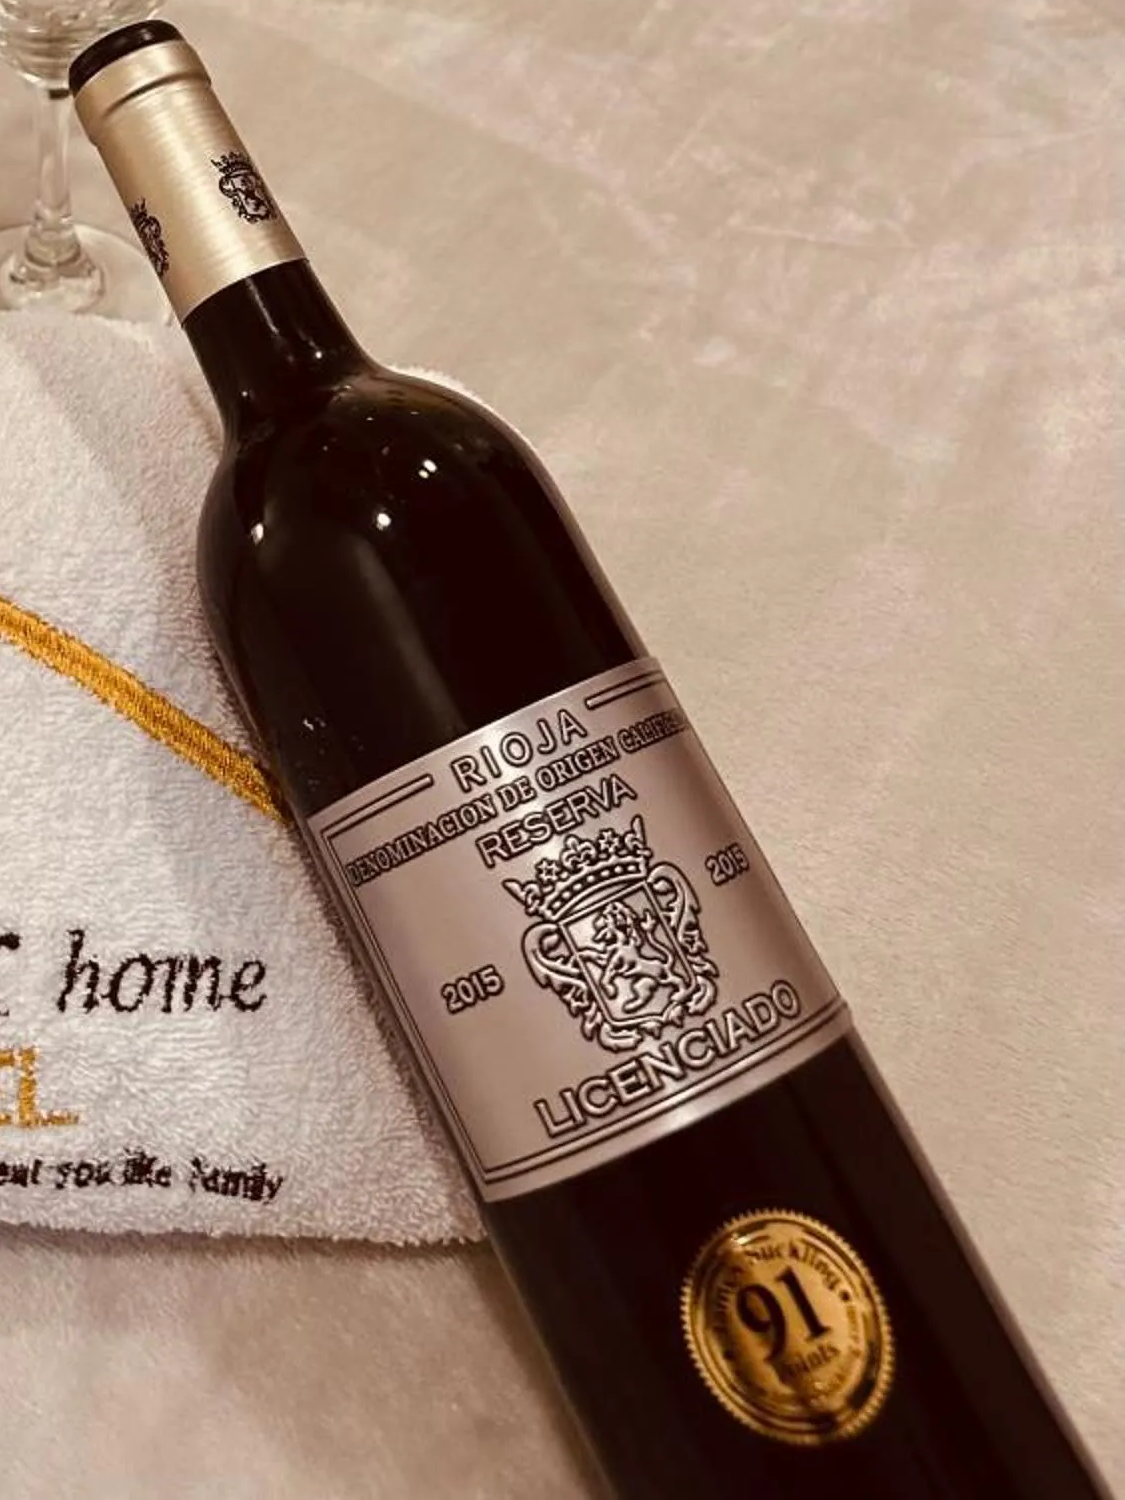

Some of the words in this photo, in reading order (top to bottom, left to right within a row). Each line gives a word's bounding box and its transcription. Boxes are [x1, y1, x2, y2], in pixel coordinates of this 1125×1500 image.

[450, 708, 588, 794] RIOJA
[346, 793, 498, 887] DENOMINACION
[496, 775, 537, 812] DE
[535, 734, 621, 791] ORIGEN
[475, 772, 637, 869] RESERVA
[704, 843, 750, 886] 2015
[55, 928, 269, 1017] home
[440, 965, 506, 1015] 2015
[535, 979, 801, 1138] LICENCIADO
[736, 1265, 831, 1364] 91
